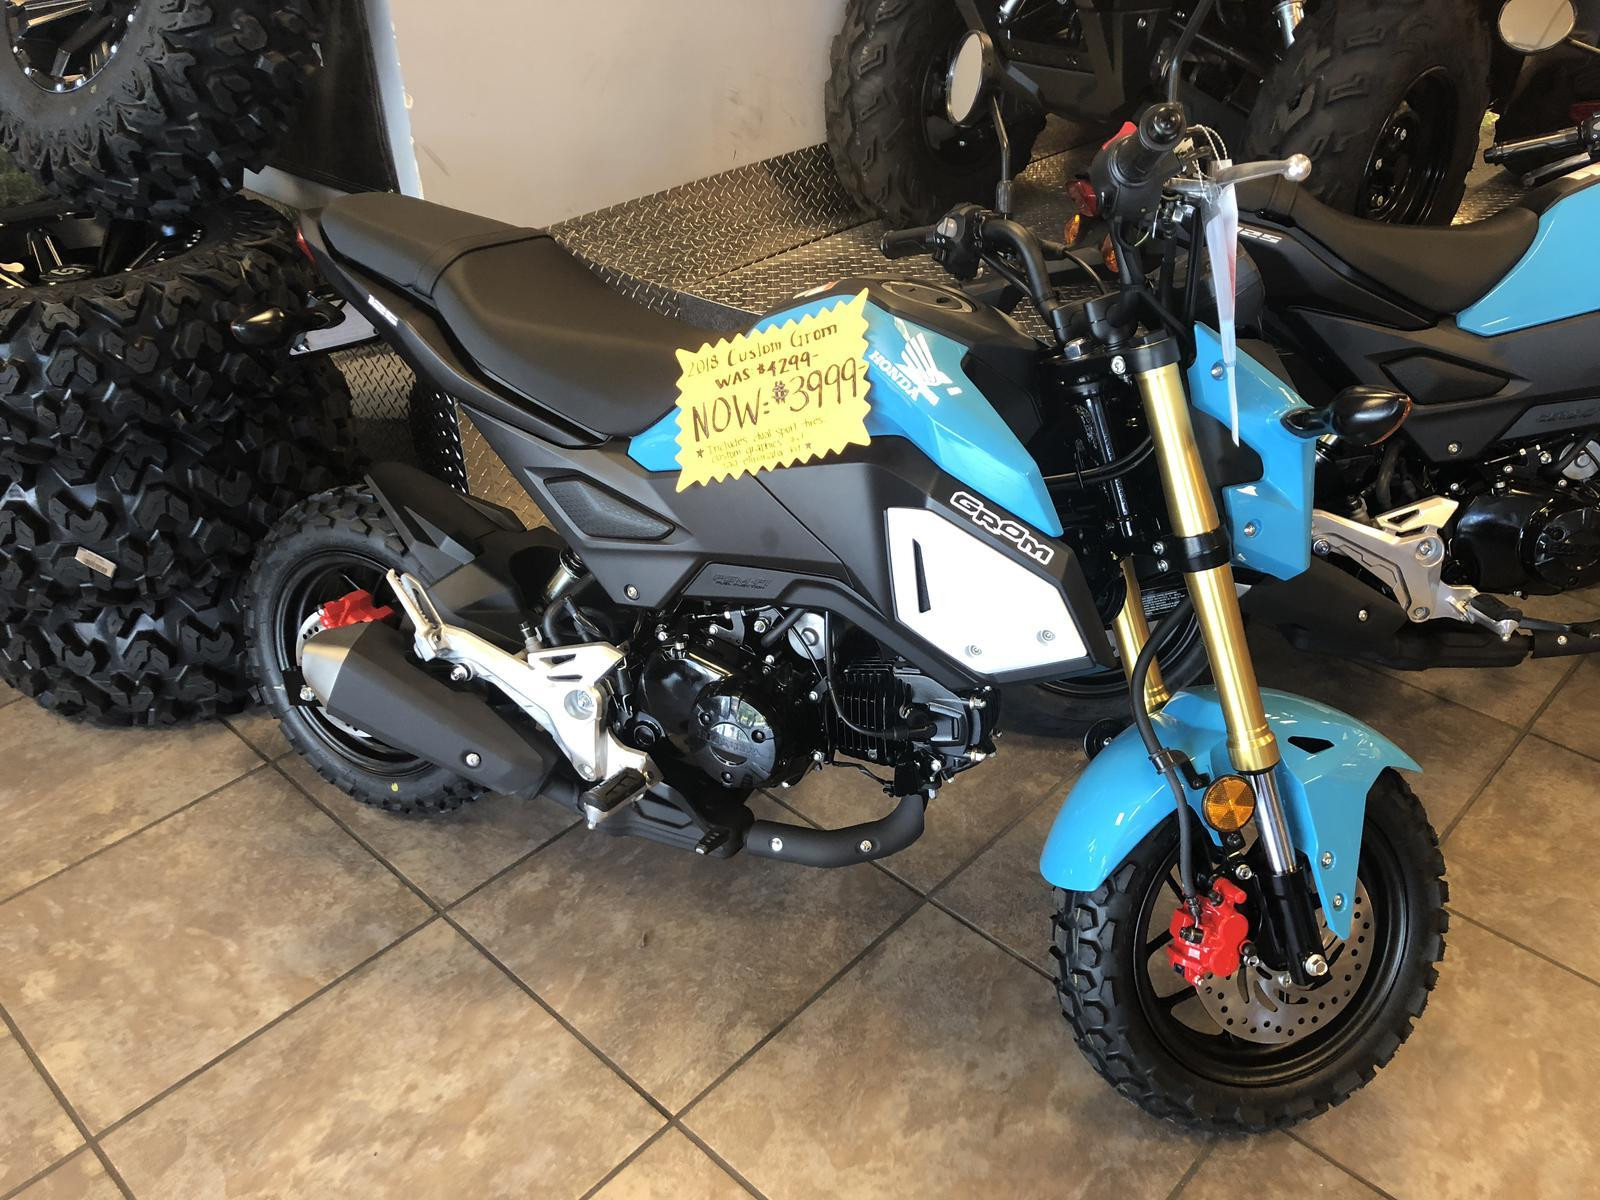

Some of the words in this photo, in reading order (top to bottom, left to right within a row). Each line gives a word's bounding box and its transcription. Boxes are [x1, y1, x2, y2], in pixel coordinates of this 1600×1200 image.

[687, 357, 720, 378] 2018
[728, 341, 783, 367] Custom
[790, 323, 838, 349] Grom
[868, 350, 920, 402] HONDA
[714, 369, 751, 390] WAS
[949, 490, 1055, 565] GROM
